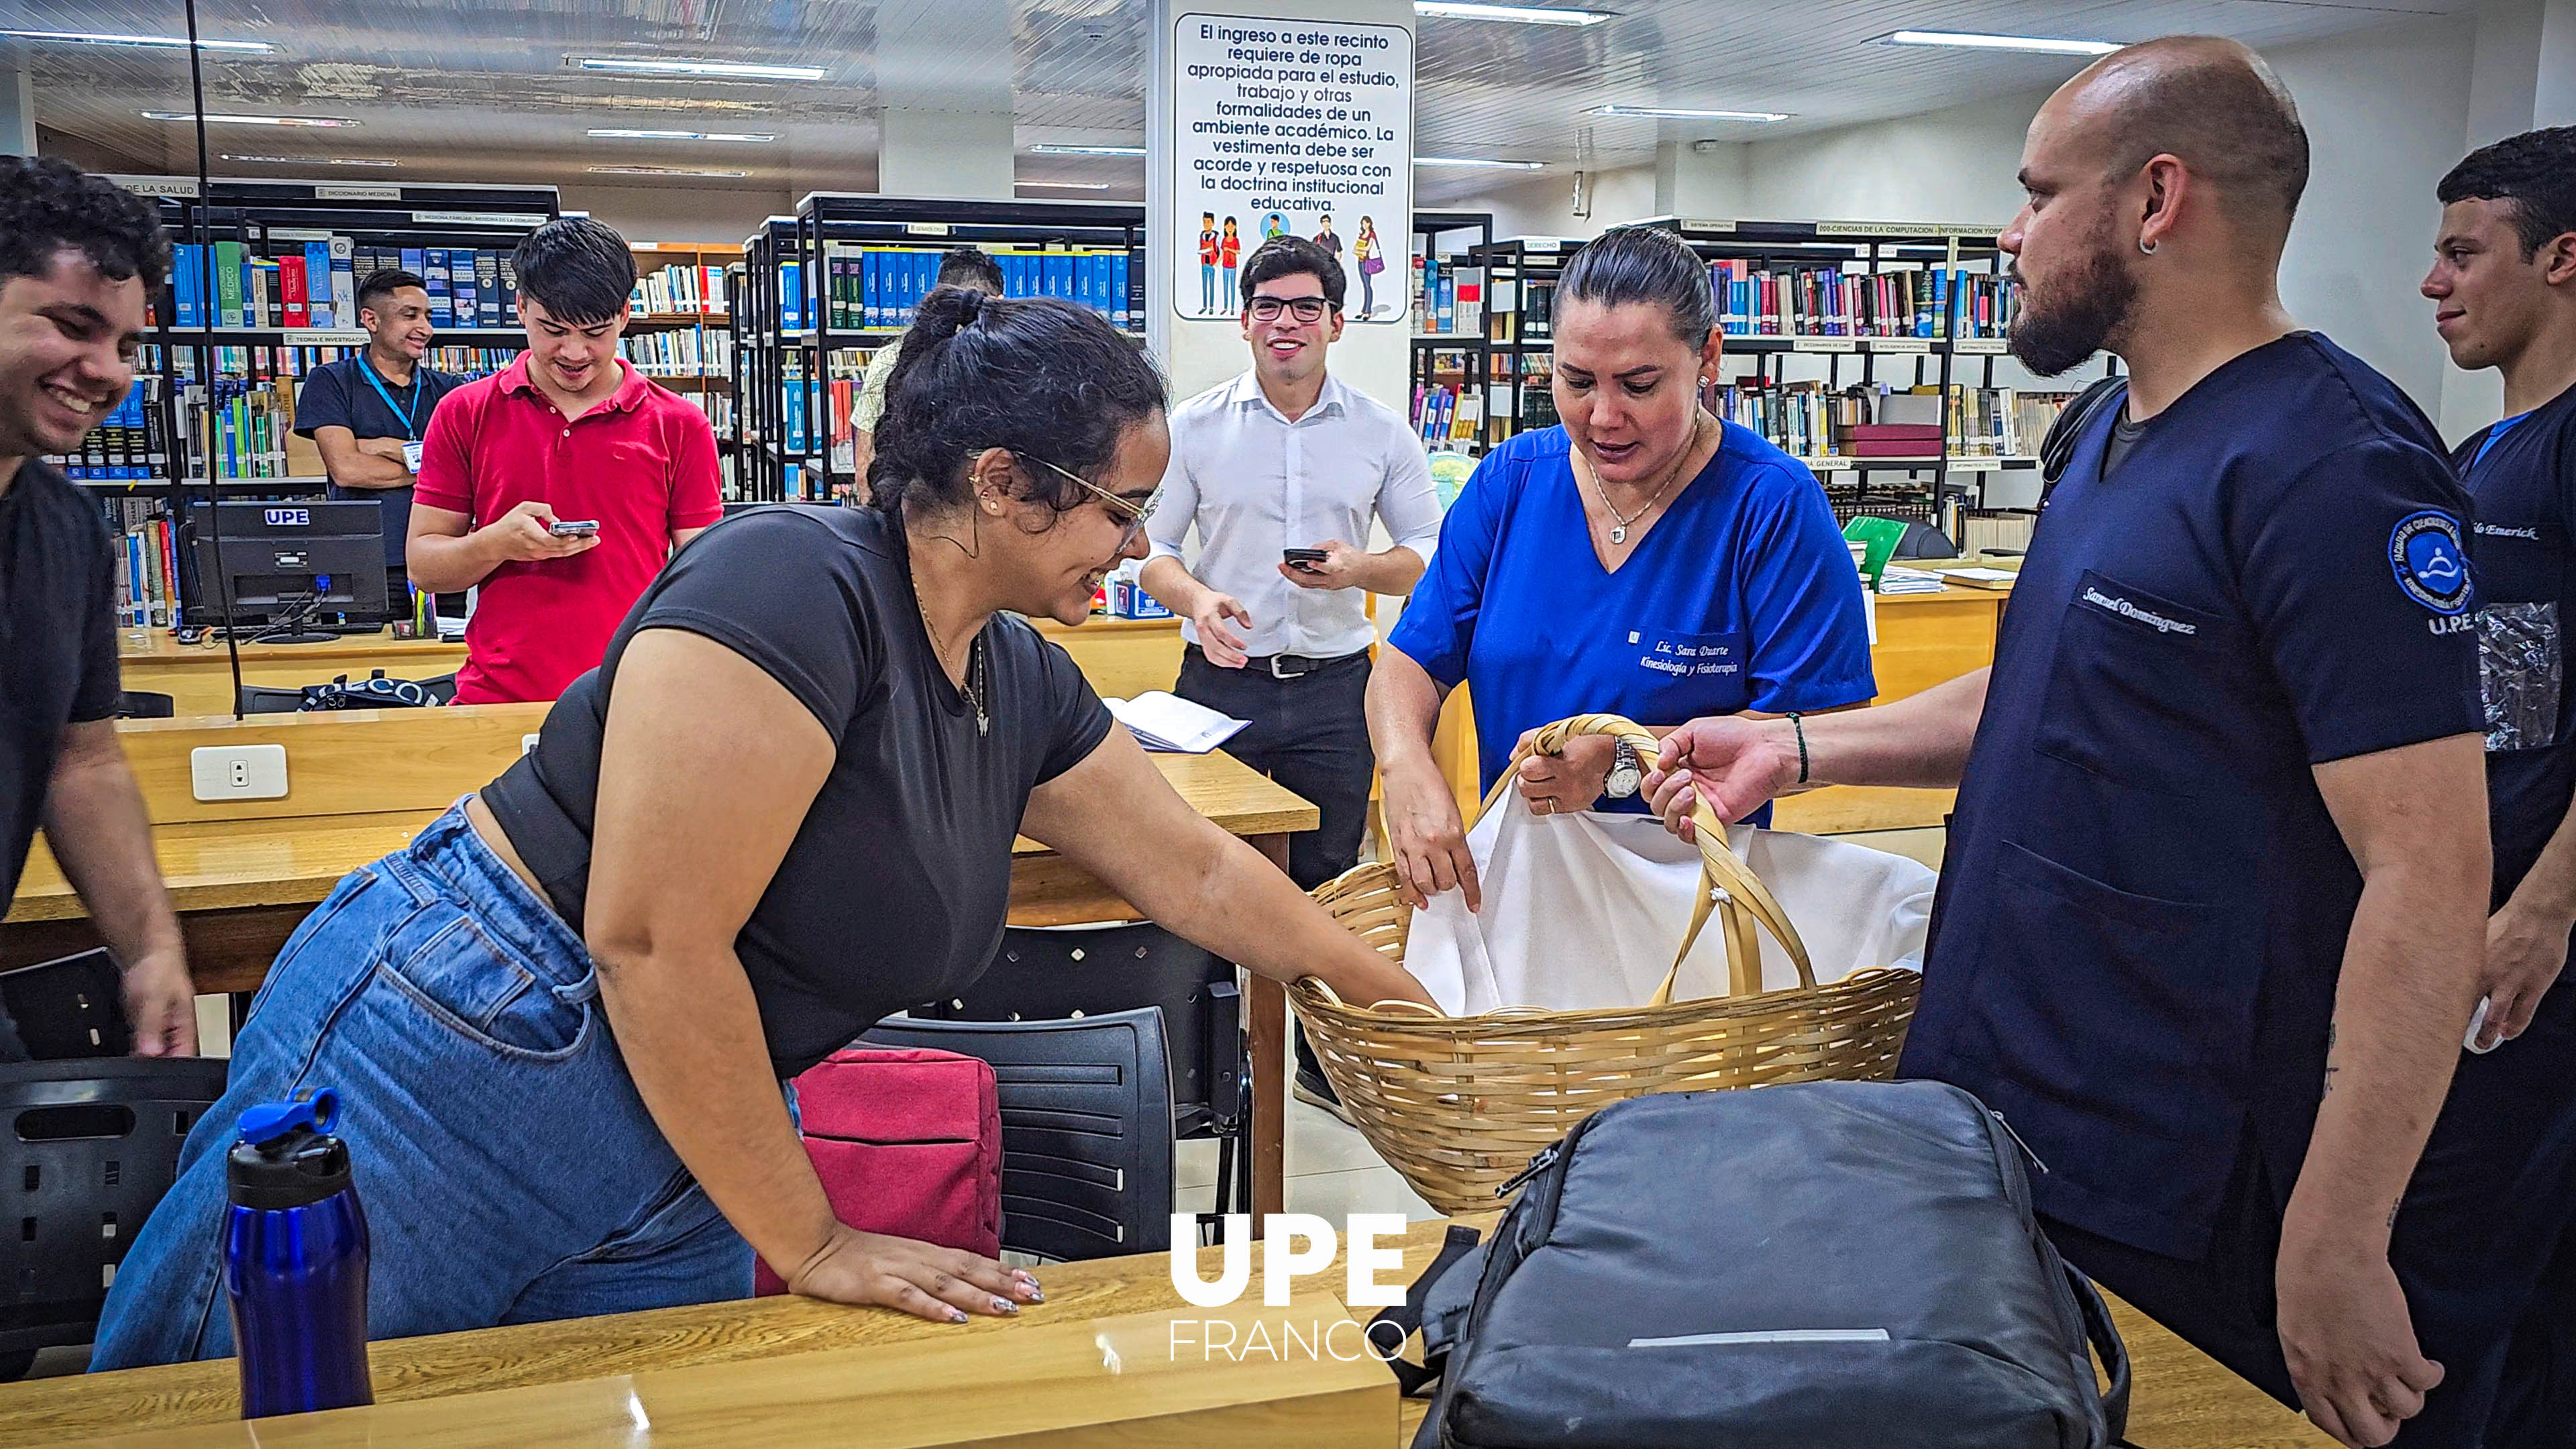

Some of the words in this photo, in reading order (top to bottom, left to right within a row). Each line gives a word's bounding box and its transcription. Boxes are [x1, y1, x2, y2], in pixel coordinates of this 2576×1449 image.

[1201, 24, 1212, 39] El
[1218, 25, 1276, 44] ingreso
[1281, 33, 1291, 44] a
[1297, 31, 1329, 46] este
[1335, 34, 1388, 49] recinto
[1228, 47, 1294, 63] requiere
[1299, 50, 1320, 64] de
[1326, 54, 1361, 68] ropa
[1188, 64, 1273, 80] apropiada
[1279, 70, 1315, 83] para
[1320, 69, 1334, 83] el
[1339, 71, 1398, 89] estudio,
[1237, 83, 1295, 102] trabajo
[1300, 90, 1308, 103] y
[1314, 88, 1351, 102] otras
[1217, 101, 1322, 119] formalidades
[1327, 107, 1347, 120] de
[1352, 111, 1370, 121] un
[1193, 119, 1269, 136] ambiente
[1275, 123, 1371, 140] académico.
[1377, 127, 1393, 141] La
[1213, 140, 1300, 155] vestimenta
[1305, 142, 1346, 157] debe
[1352, 147, 1374, 158] ser
[1194, 158, 1252, 172] acorde
[1257, 162, 1266, 175] y
[1272, 161, 1356, 176] respetuosa
[1362, 166, 1391, 177] con
[143, 185, 156, 193] LA
[160, 186, 195, 195] SALUD
[1202, 175, 1215, 189] la
[1221, 176, 1287, 191] doctrina
[1293, 178, 1383, 195] institucional
[1251, 196, 1335, 211] educativa.
[268, 511, 308, 524] UPE
[2485, 525, 2539, 541] Emerick
[2082, 587, 2124, 612] Samuel
[1655, 641, 1672, 653] Lic.
[1675, 644, 1696, 657] Sara
[1699, 645, 1729, 657] Duarte
[1640, 657, 1686, 676] Kinesiología
[1687, 665, 1695, 676] y
[1697, 661, 1737, 676] Fisioterapia
